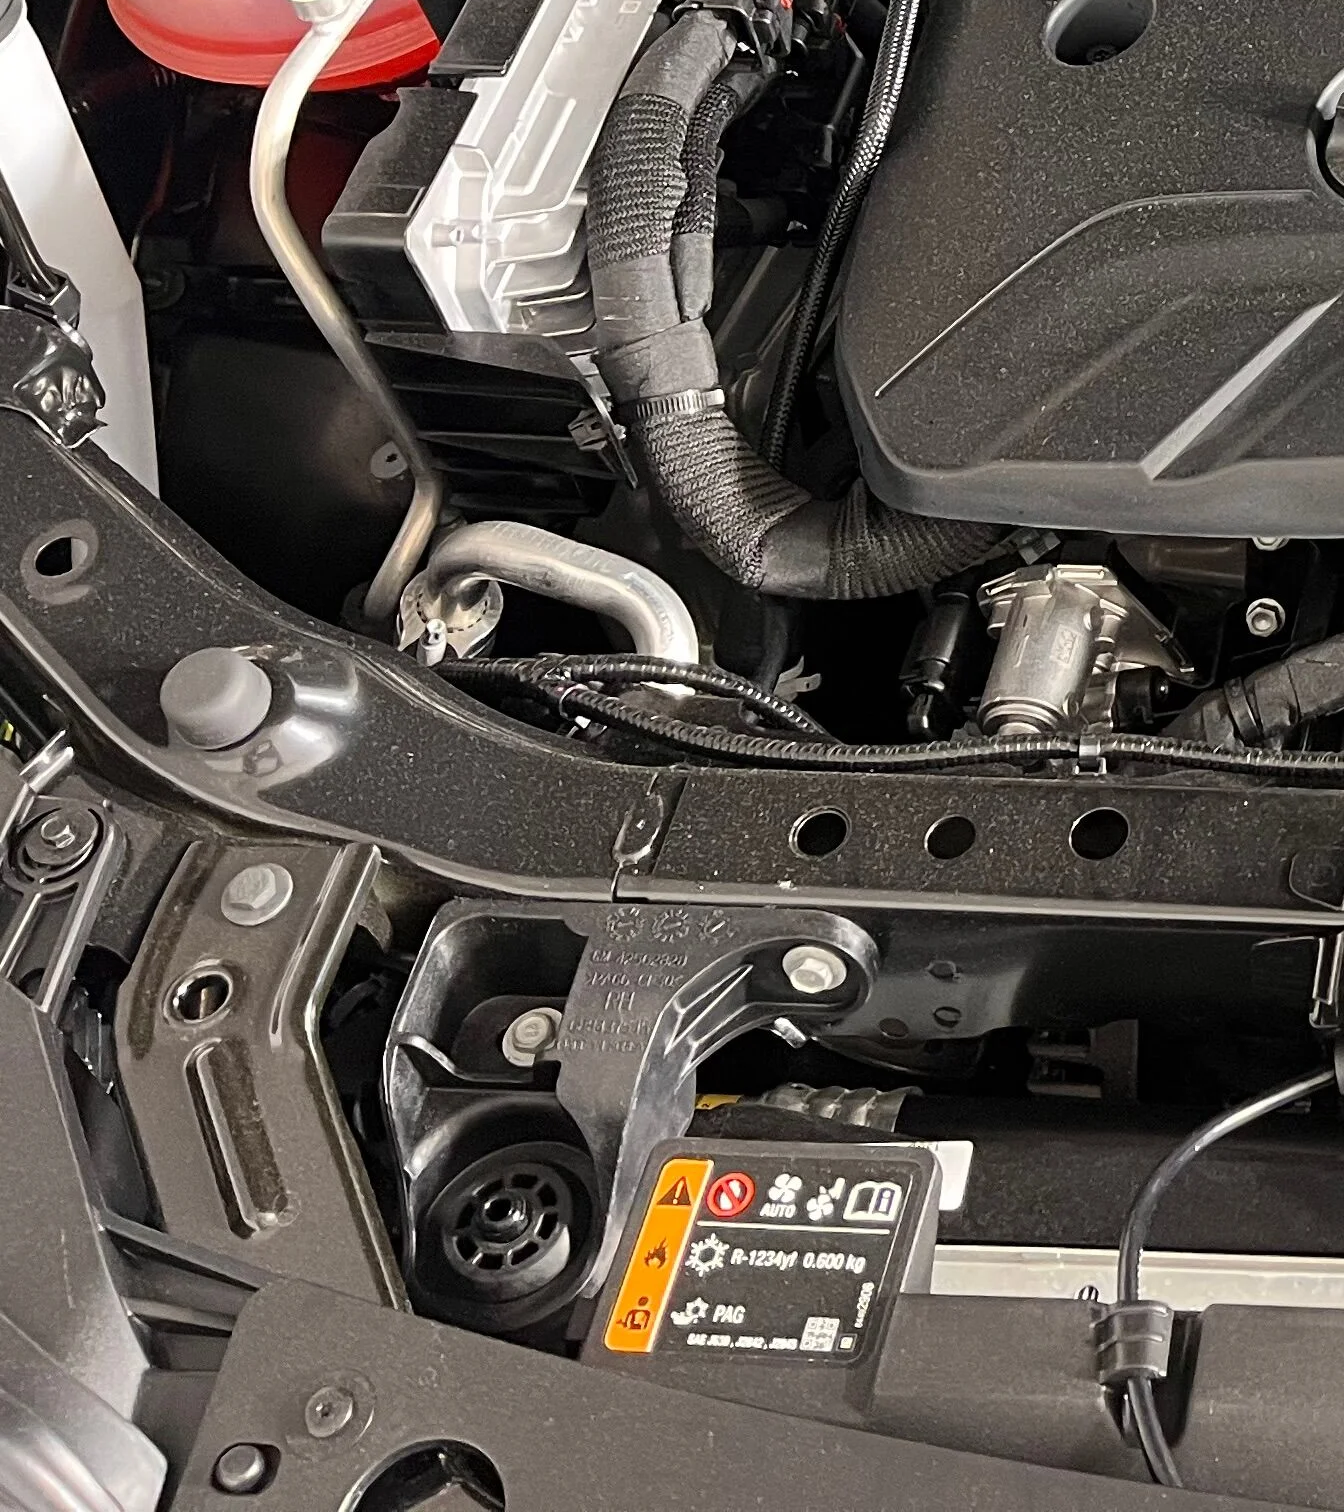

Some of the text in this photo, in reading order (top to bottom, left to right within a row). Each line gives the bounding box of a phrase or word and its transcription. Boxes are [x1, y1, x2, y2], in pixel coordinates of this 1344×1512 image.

[604, 991, 636, 1011] RH
[760, 1202, 796, 1219] AUTO
[730, 1248, 866, 1275] R-1234yf 0.600 kg
[712, 1303, 746, 1324] PAG
